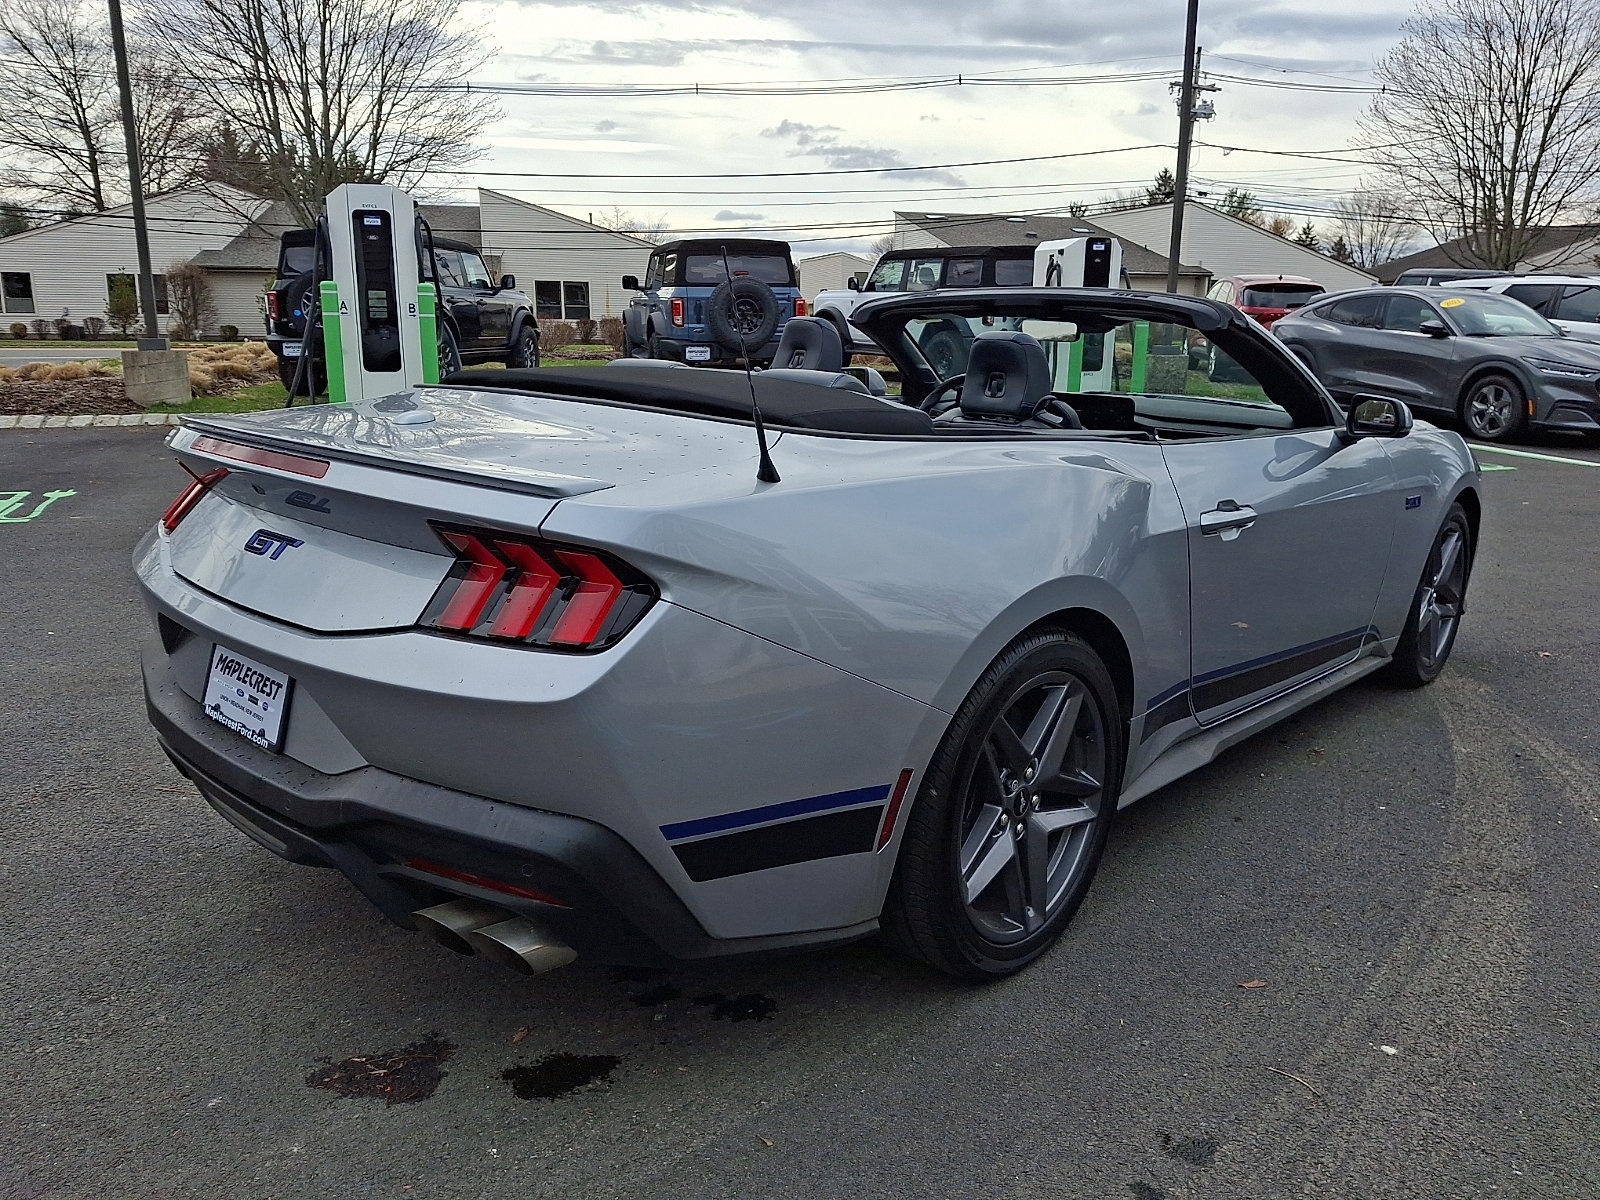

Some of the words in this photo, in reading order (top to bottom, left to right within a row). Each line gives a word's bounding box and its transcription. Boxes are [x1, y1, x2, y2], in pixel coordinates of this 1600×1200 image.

[339, 300, 348, 311] A
[408, 303, 416, 313] B
[243, 528, 305, 561] GT
[214, 653, 284, 701] MAPLECREST
[204, 705, 269, 749] MaplecrestFord.com
